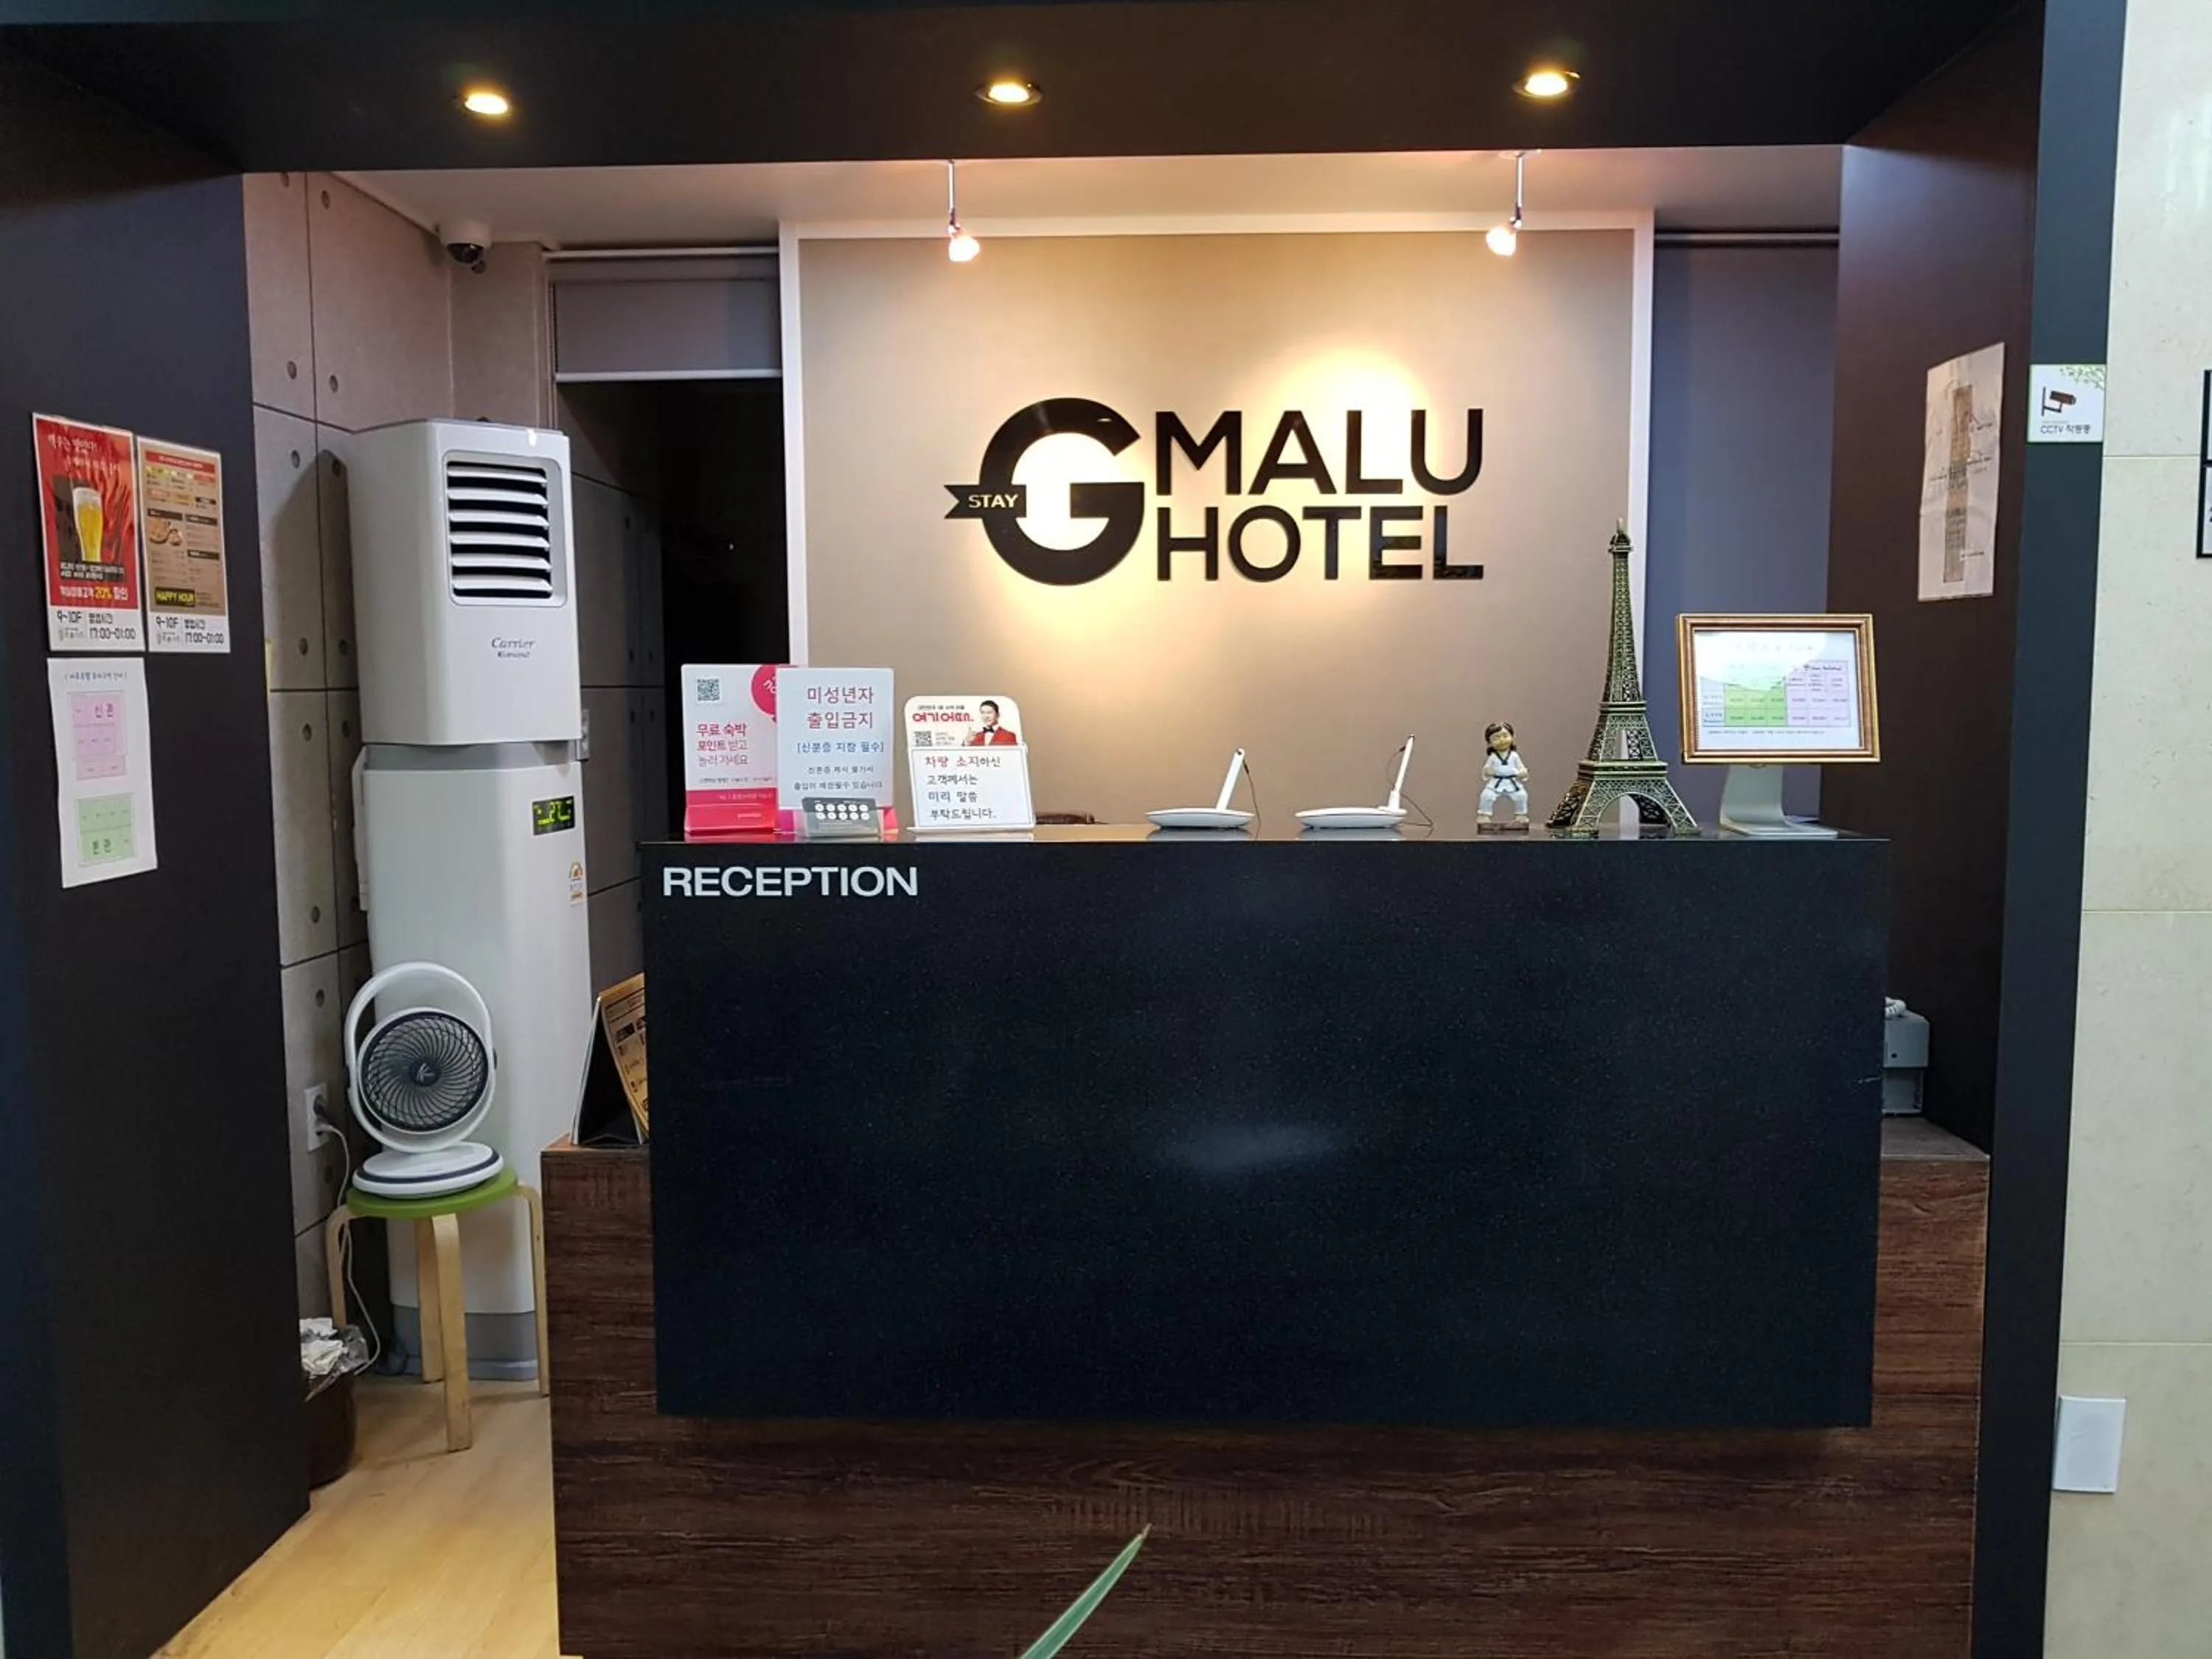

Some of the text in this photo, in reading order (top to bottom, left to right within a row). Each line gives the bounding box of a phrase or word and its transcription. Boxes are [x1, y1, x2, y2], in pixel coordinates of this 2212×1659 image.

[2040, 424, 2065, 434] CCTV
[1155, 408, 1484, 496] MALU
[967, 494, 1019, 509] STAY
[1156, 504, 1484, 582] HOTEL
[492, 636, 536, 649] Carrier
[807, 686, 874, 704] 미성년자
[807, 712, 874, 729] 출입금지
[695, 723, 746, 737] 무료 숙박
[696, 740, 749, 751] 포인트 받고
[925, 756, 1001, 768] 차량 소지하신
[926, 774, 978, 785] 고객께서는
[928, 790, 978, 803] 미리 말씀
[931, 807, 998, 821] 부탁드립니다.
[663, 866, 919, 897] RECEPTION
